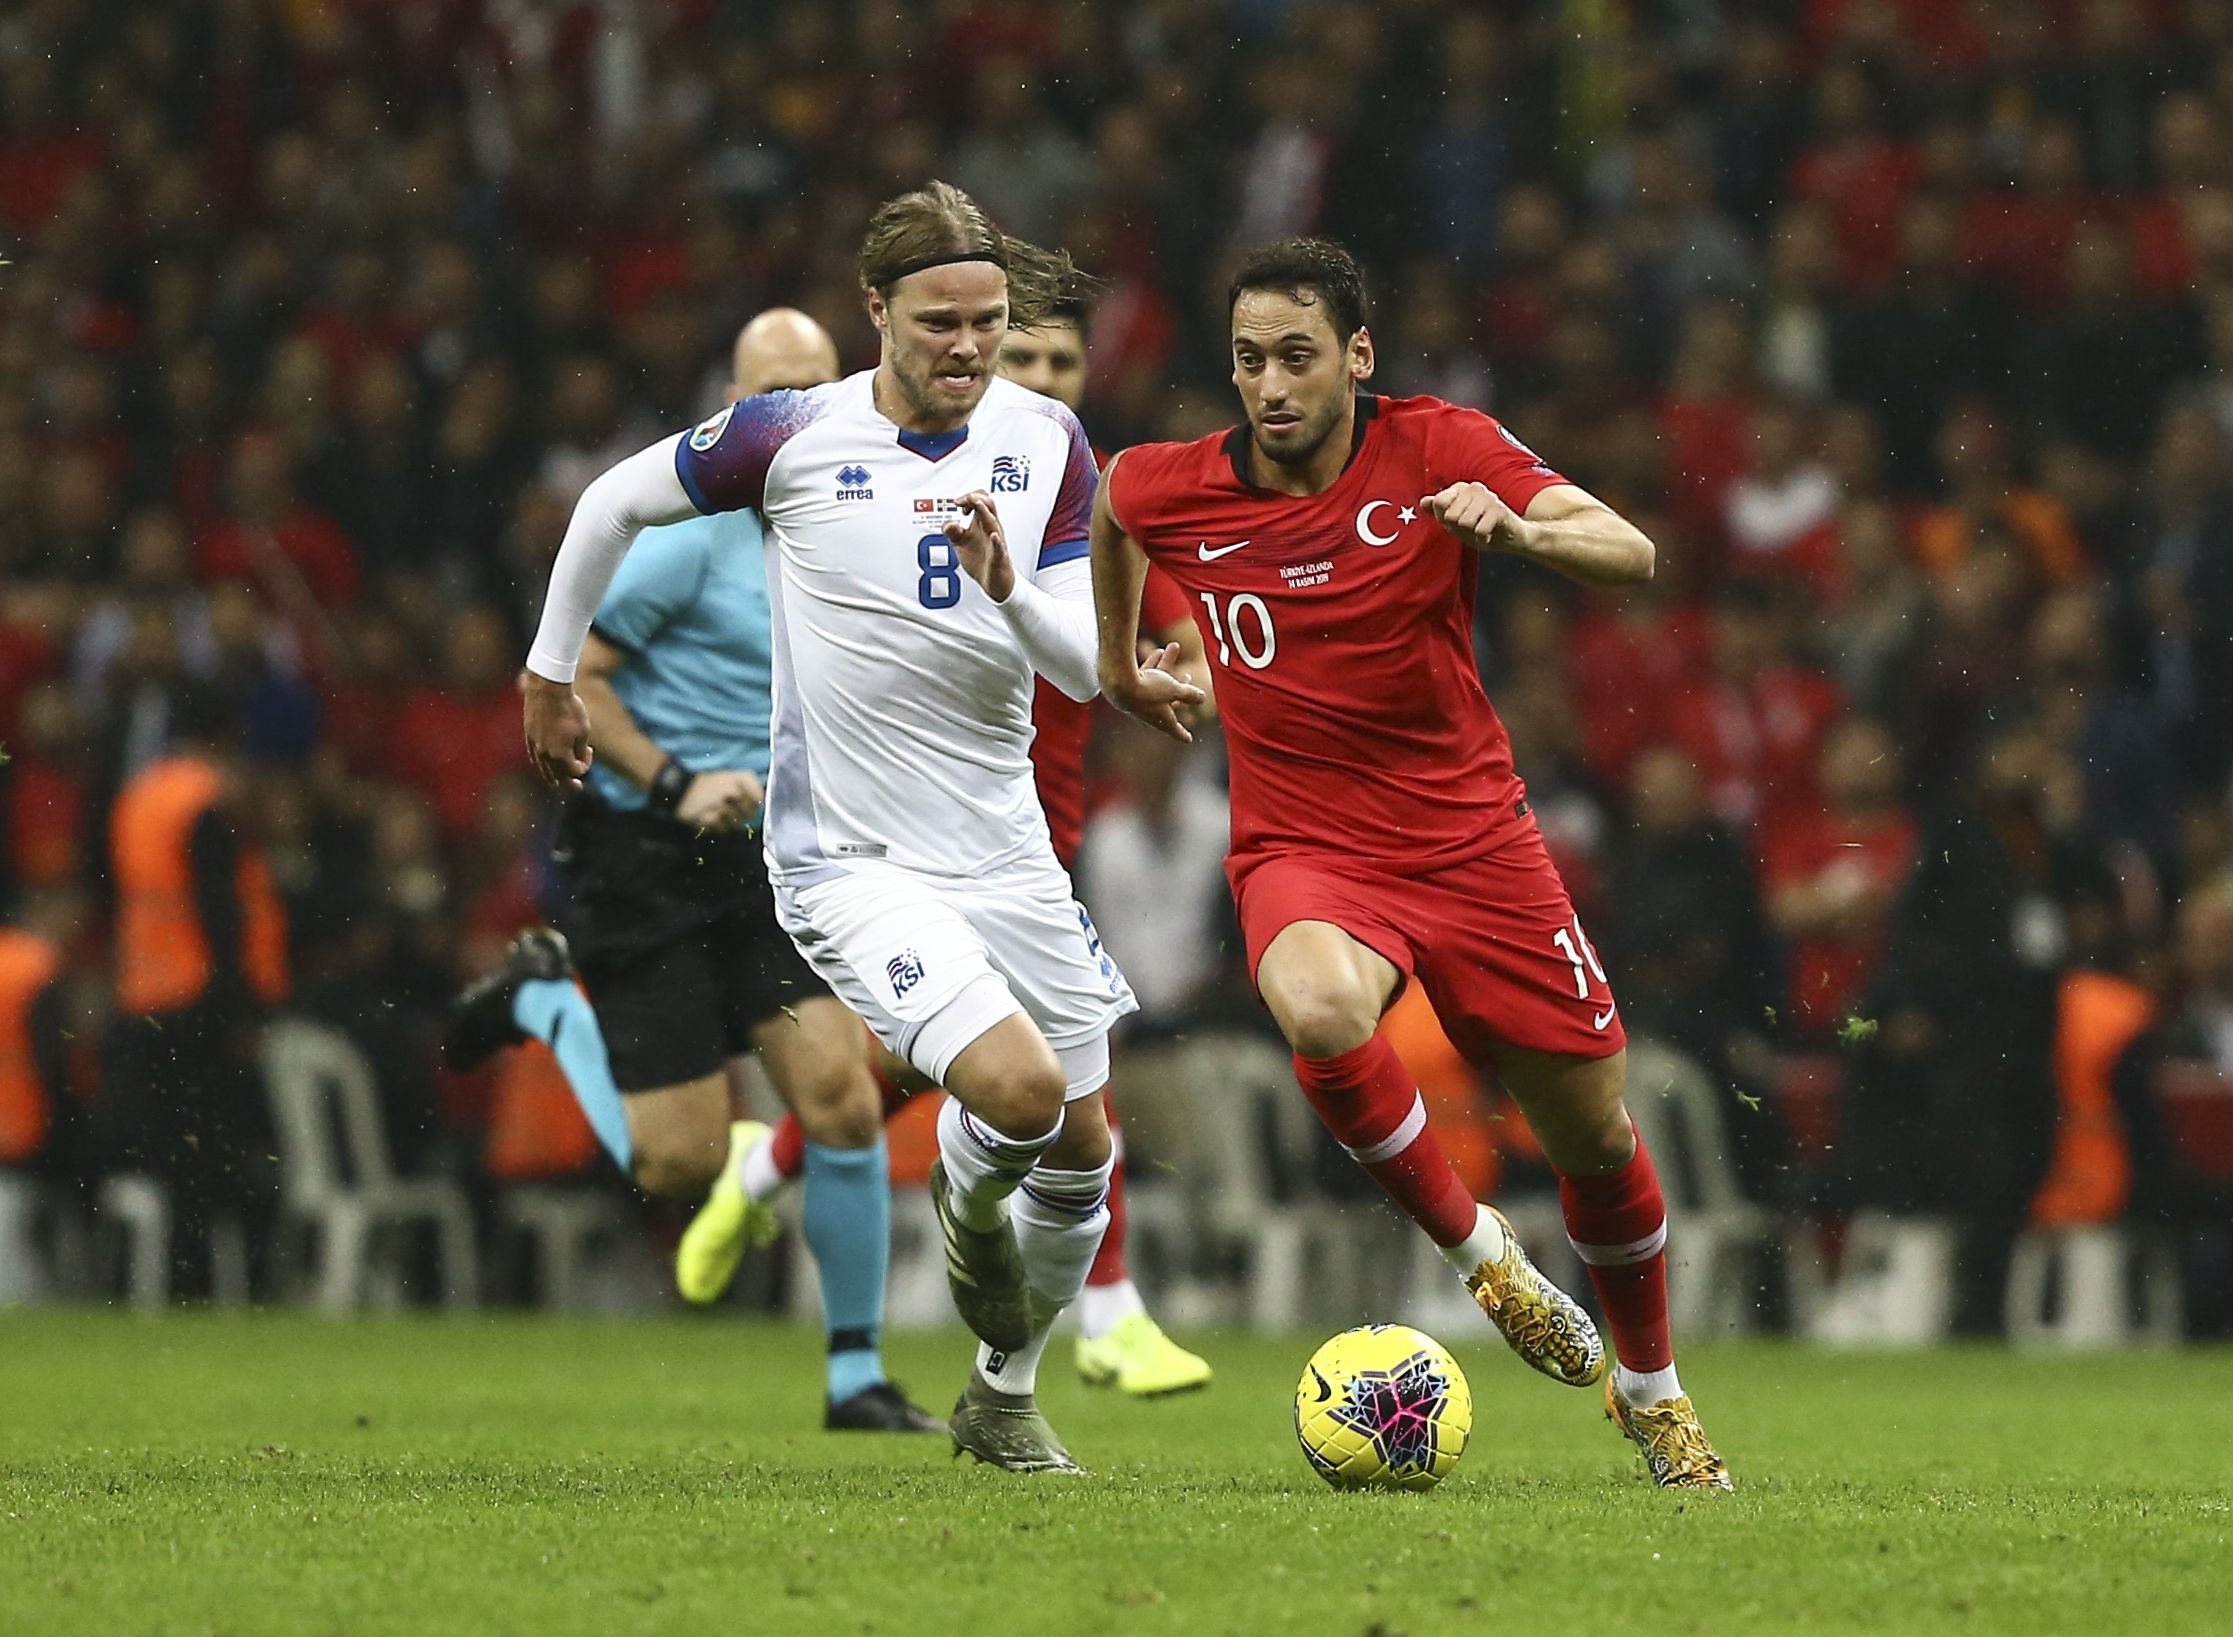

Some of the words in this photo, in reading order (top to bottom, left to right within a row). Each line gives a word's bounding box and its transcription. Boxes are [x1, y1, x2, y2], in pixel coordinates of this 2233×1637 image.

[836, 488, 874, 501] errea
[917, 533, 961, 609] 8
[1201, 592, 1276, 670] 10
